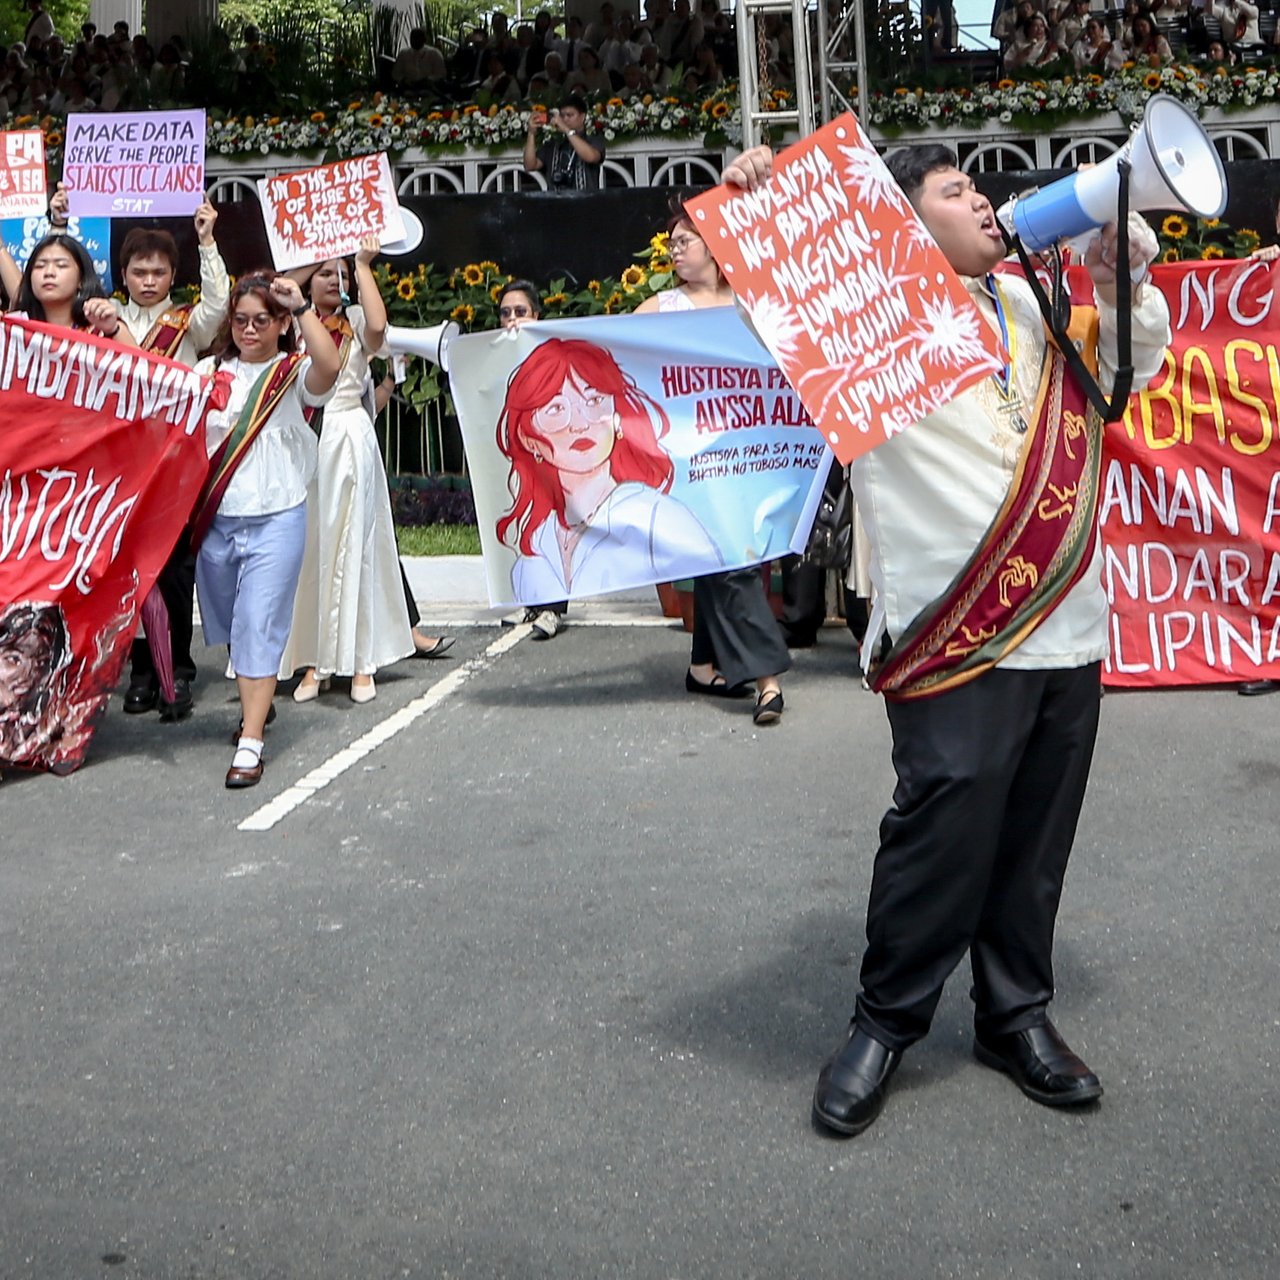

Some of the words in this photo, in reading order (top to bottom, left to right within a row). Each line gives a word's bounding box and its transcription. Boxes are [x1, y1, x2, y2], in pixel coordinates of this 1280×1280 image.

[73, 122, 139, 143] MAKE
[142, 120, 194, 142] DATA
[68, 144, 114, 164] SERVE
[119, 147, 145, 162] THE
[148, 144, 200, 164] PEOPLE
[64, 163, 203, 195] STATISTICIANS!
[271, 180, 289, 203] IN
[292, 167, 332, 194] THE
[333, 155, 379, 186] LINE
[720, 144, 833, 239] KONSENSYA
[111, 197, 154, 214] STAT
[285, 196, 307, 215] OF
[310, 186, 347, 211] FIRE
[349, 181, 365, 200] IS
[294, 204, 342, 233] PLACE
[346, 198, 370, 217] OF
[303, 209, 384, 247] STRUGGLE
[737, 226, 776, 273] NG
[774, 170, 849, 254] BAYAN
[796, 256, 893, 344] LUMABAN
[821, 285, 911, 366] BAGUHIN
[661, 364, 764, 400] HUSTISYA
[837, 346, 926, 426] LIPUNAN
[695, 394, 768, 436] ALYSSA
[742, 442, 770, 460] PARA
[772, 441, 790, 455] SA
[793, 441, 806, 454] 19
[688, 465, 731, 484] BIKTIMA
[748, 457, 790, 474] TOBOSO
[1098, 458, 1242, 538] ANAN
